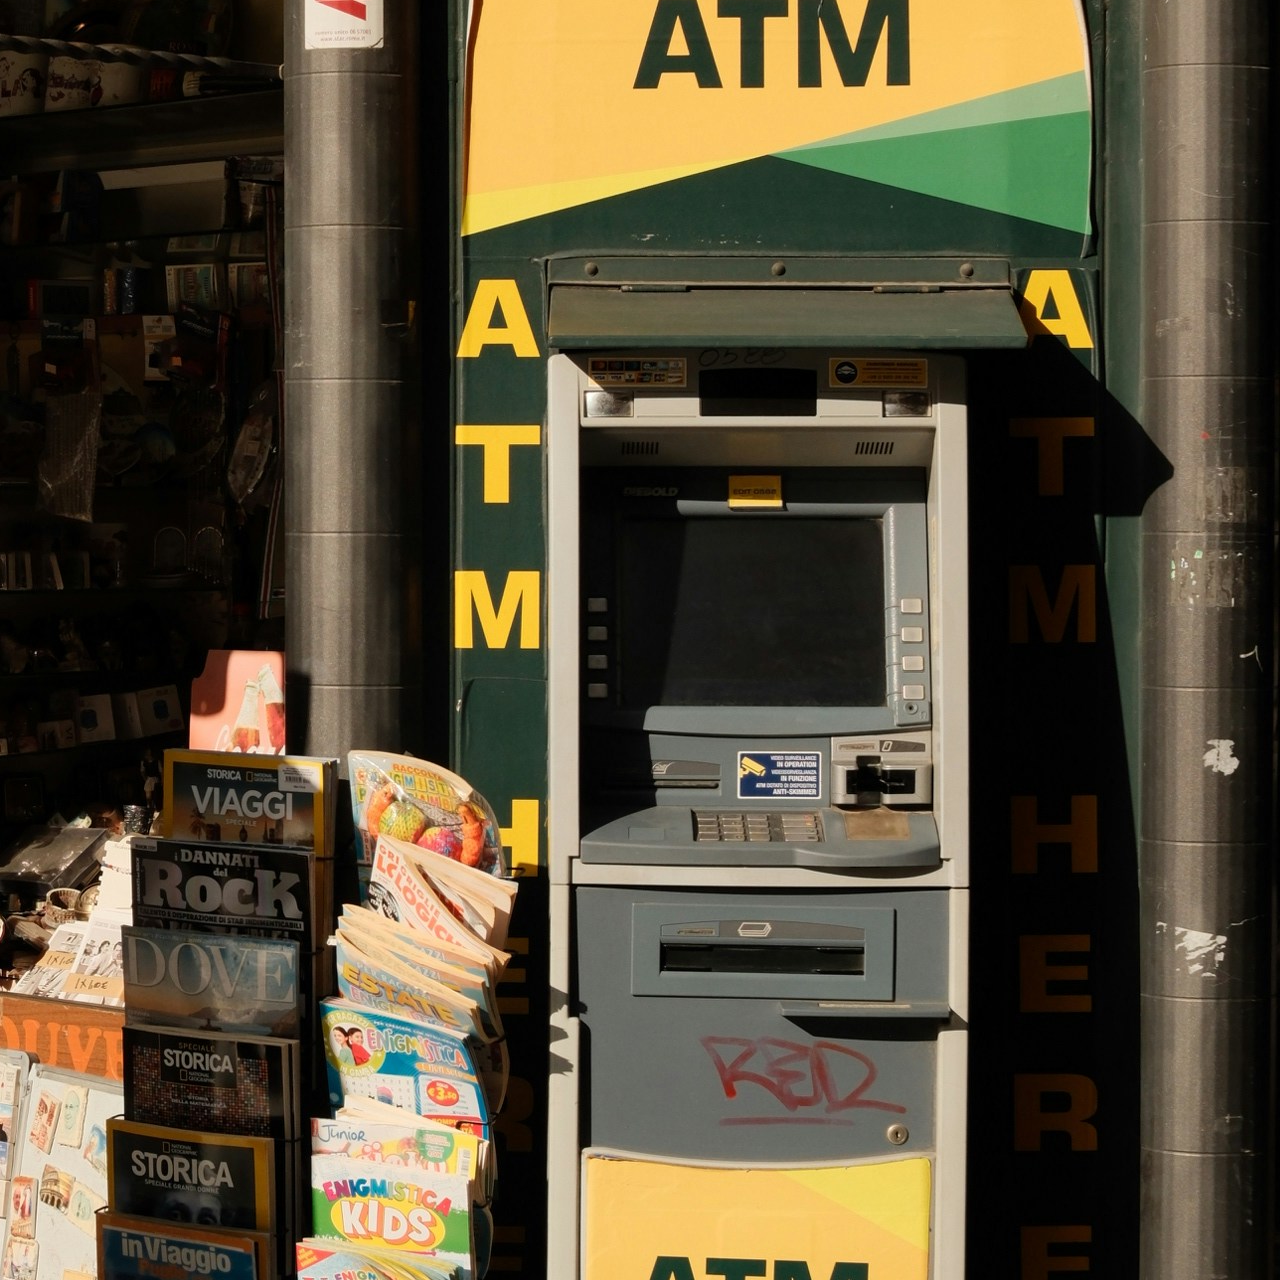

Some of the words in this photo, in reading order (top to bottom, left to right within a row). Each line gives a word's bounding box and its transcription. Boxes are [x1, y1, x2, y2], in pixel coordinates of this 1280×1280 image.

[455, 279, 541, 650] ATM
[1009, 269, 1097, 643] ATM
[623, 486, 680, 496] DIEBOLD
[206, 768, 242, 781] STORICA
[191, 784, 292, 820] VIAGGI
[180, 848, 260, 868] DANNATI
[213, 868, 228, 877] del
[139, 908, 166, 917] TALENTO
[172, 911, 219, 923] DISPERAZIONE
[246, 918, 302, 929] INDIMENTICABILI
[124, 936, 294, 1002] DOVE
[342, 962, 461, 1026] ESTATE
[164, 1048, 234, 1073] STORICA
[178, 1042, 216, 1052] SPECIALE
[366, 1028, 469, 1070] ENIGMISTICA
[131, 1150, 234, 1188] STORICA
[144, 1178, 172, 1190] SPECIALE
[173, 1183, 196, 1192] GRANDI
[197, 1186, 220, 1194] DONNE
[323, 1178, 452, 1217] ENIGMISTICA
[341, 1200, 436, 1246] KIDS
